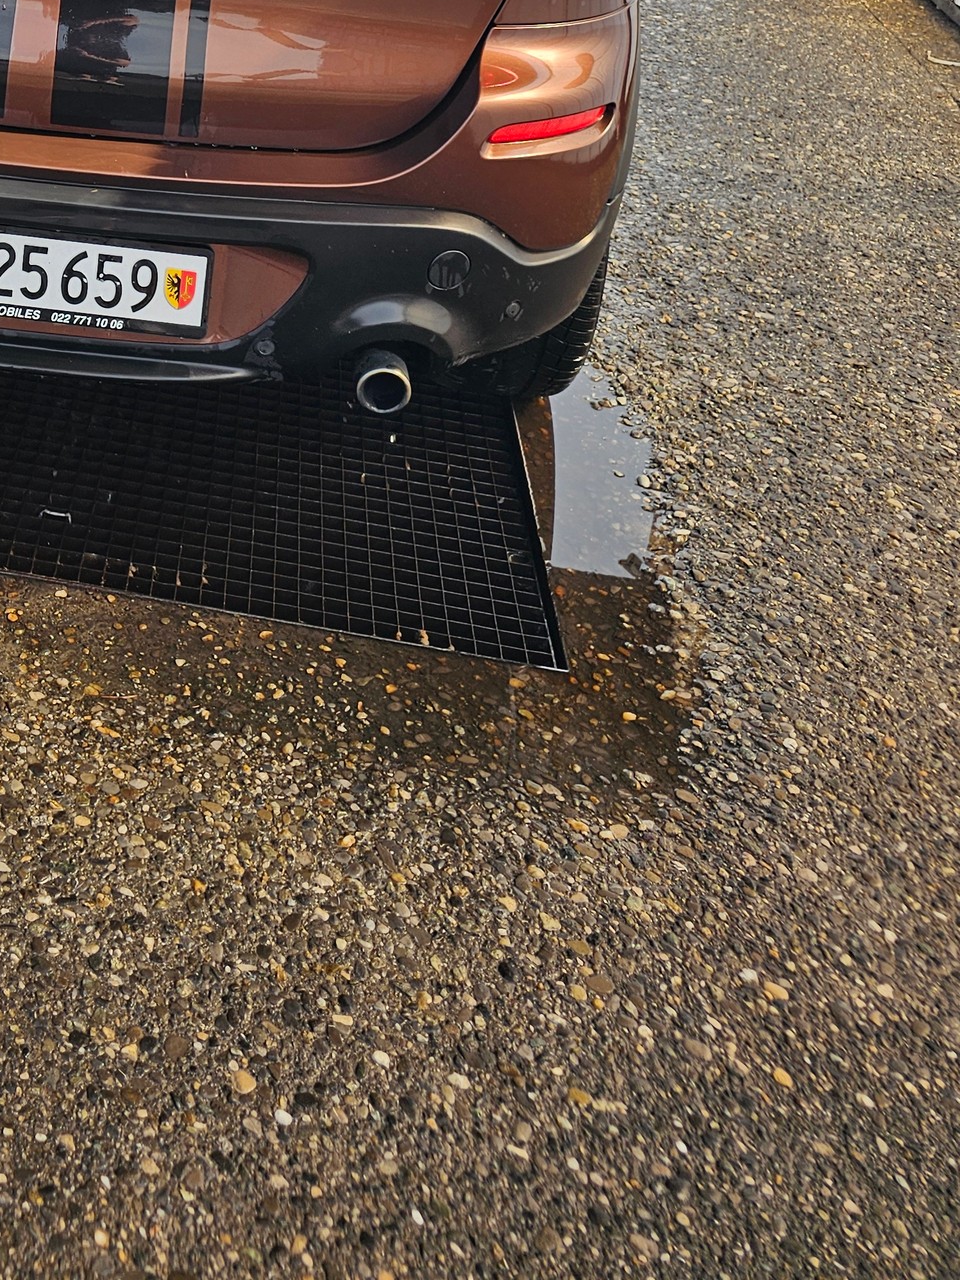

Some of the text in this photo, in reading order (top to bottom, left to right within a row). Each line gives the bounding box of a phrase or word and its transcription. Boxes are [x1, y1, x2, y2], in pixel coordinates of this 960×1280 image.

[51, 312, 71, 324] 022
[73, 314, 92, 326] 771
[95, 317, 109, 328] 10
[109, 319, 124, 330] 06
